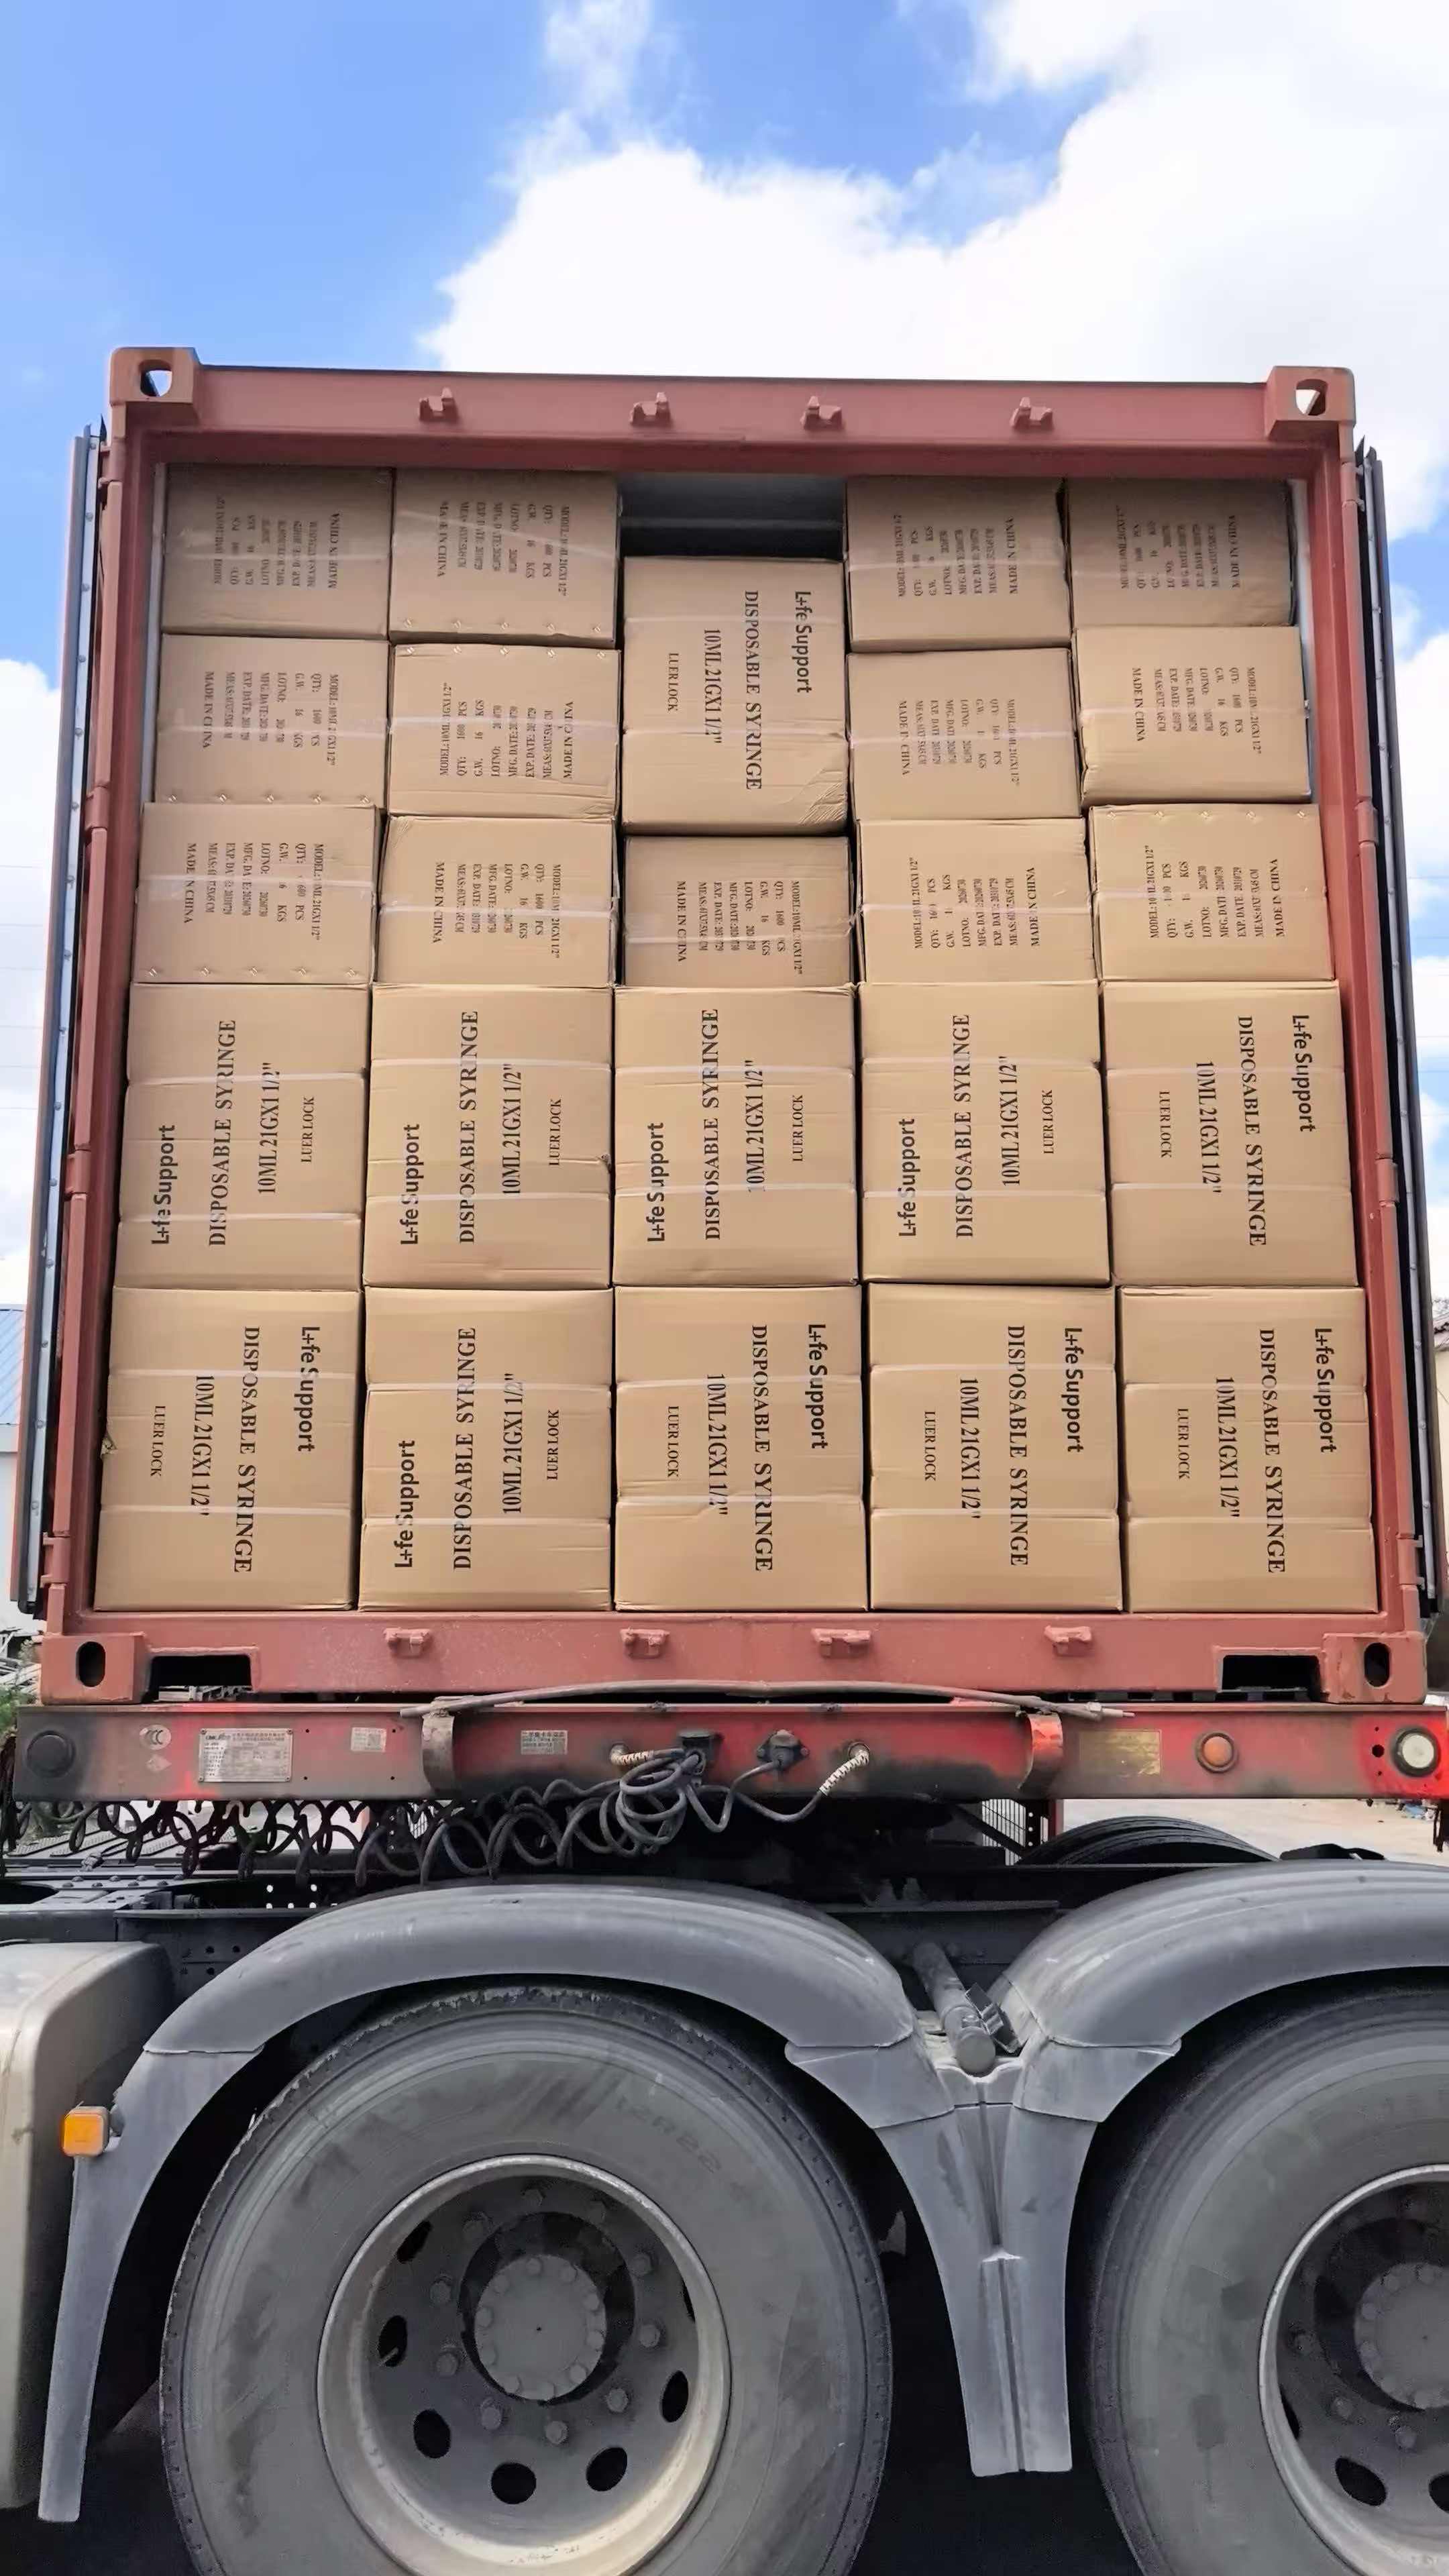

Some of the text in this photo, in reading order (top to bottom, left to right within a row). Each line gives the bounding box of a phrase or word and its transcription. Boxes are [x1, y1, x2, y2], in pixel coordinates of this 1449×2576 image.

[667, 653, 679, 711] LUER LOCK
[704, 629, 721, 666] 10ML
[792, 625, 813, 693] Support
[1230, 667, 1240, 684] QTY:
[205, 672, 214, 701] MADE
[205, 704, 213, 713] IN
[458, 702, 468, 716] PCS
[475, 700, 484, 716] KGS
[745, 591, 762, 790] DISPOSABLE SYRINGE
[1132, 668, 1146, 741] MADE IN CHINA
[564, 702, 574, 778] MADE IN CINA
[1219, 722, 1228, 736] KGS
[1234, 720, 1243, 733] PCS
[458, 757, 467, 776] QTY:
[433, 862, 445, 943] MADE IN CHINA
[535, 864, 544, 882] QTY:
[775, 881, 784, 899] QTY:
[1269, 859, 1285, 936] MADE IN CHINA
[519, 922, 528, 938] KGS
[535, 920, 543, 935] PCS
[761, 940, 771, 955] KGS
[1196, 1061, 1217, 1106] 10ML
[1291, 1053, 1316, 1132] Support
[209, 1020, 236, 1246] DISPOSABLE SYRINGE
[301, 1097, 314, 1163] LUER LOCK
[460, 1012, 478, 1244] DISPOSABLE SYRINGE
[702, 1009, 720, 1240] DISPOSABLE SYRINGE
[953, 1015, 973, 1238] DISPOSABLE SYRINGE
[1042, 1090, 1054, 1154] LUER LOCK
[1159, 1091, 1171, 1158] LUER LOCK
[1238, 1016, 1266, 1246] DISPOSABLE SYRINGE
[154, 1125, 178, 1205] Support
[258, 1150, 277, 1194] 10ML
[898, 1119, 920, 1197] Support
[1000, 1142, 1020, 1186] 10ML
[195, 1376, 215, 1421] 10ML
[294, 1367, 319, 1452] Support
[706, 1374, 727, 1421] 10ML
[805, 1365, 828, 1449] Support
[960, 1378, 979, 1424] 10ML
[1061, 1369, 1083, 1452] Support
[1216, 1377, 1236, 1424] 10ML
[1313, 1369, 1336, 1453] Support
[150, 1405, 165, 1477] LUER LOCK
[234, 1326, 260, 1572] DISPOSABLE SYRINGE
[453, 1328, 476, 1568] DISPOSABLE SYRINGE
[667, 1406, 679, 1477] LUER LOCK
[752, 1326, 772, 1571] DISPOSABLE SYRINGE
[924, 1411, 936, 1481] LUER LOCK
[1008, 1326, 1028, 1566] DISPOSABLE SYRINGE
[1177, 1409, 1189, 1480] LUER LOCK
[1260, 1329, 1285, 1573] DISPOSABLE SYRINGE
